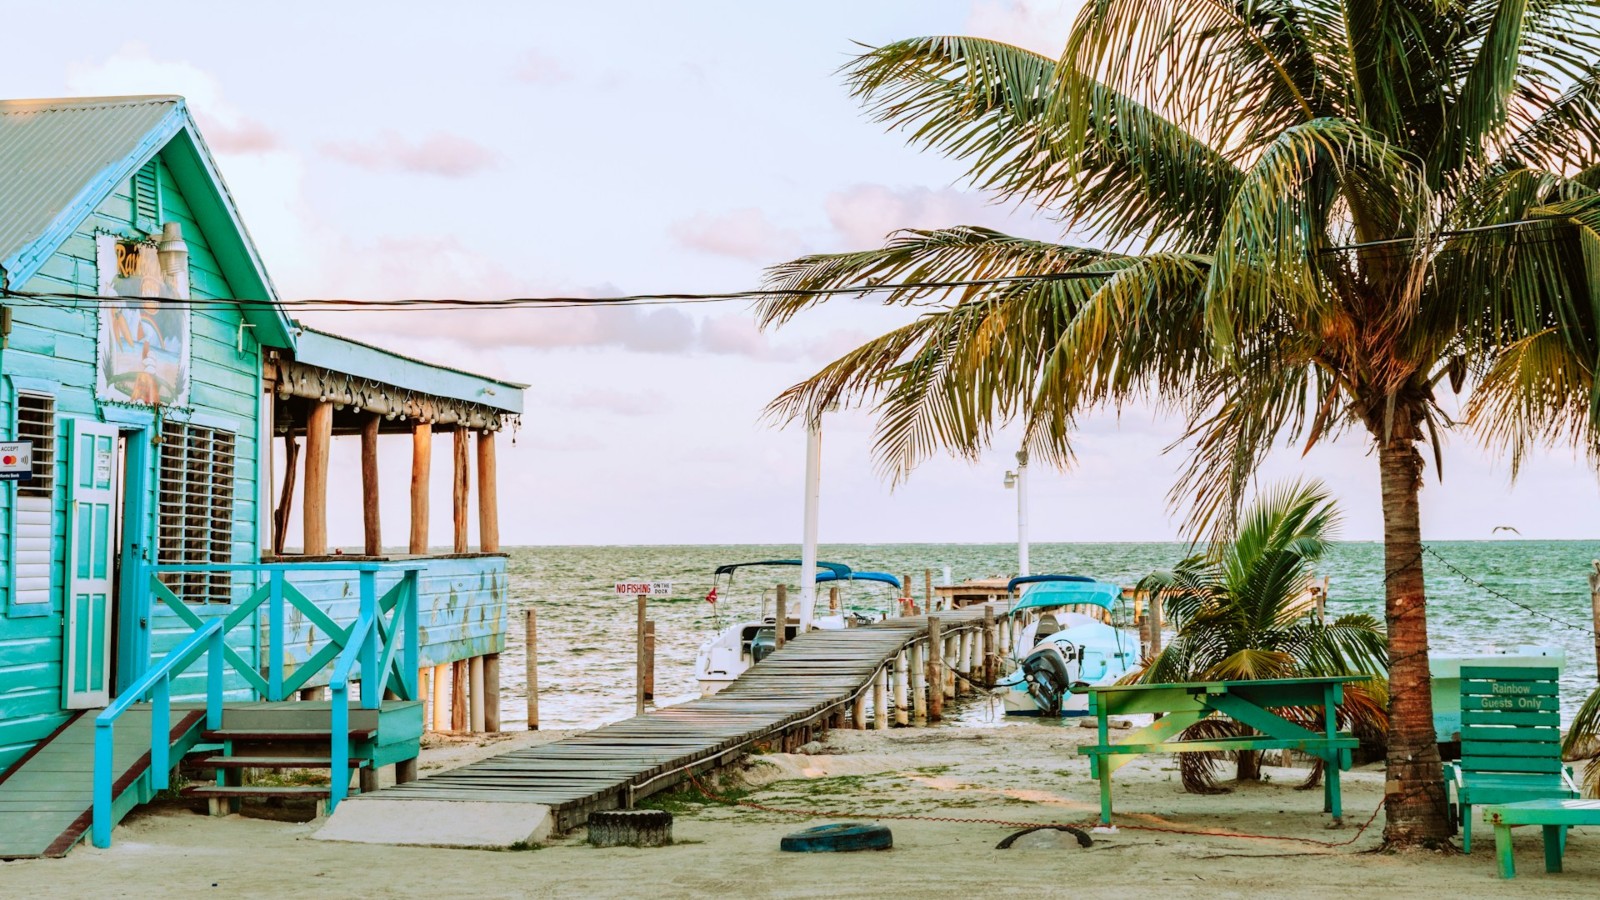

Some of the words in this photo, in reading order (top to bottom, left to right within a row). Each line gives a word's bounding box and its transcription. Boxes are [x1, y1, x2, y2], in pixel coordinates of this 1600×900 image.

[616, 584, 626, 593] NO
[627, 584, 651, 593] FISHING
[1492, 683, 1530, 694] Rainbow
[1481, 698, 1513, 708] Guests
[1518, 698, 1542, 709] Only
